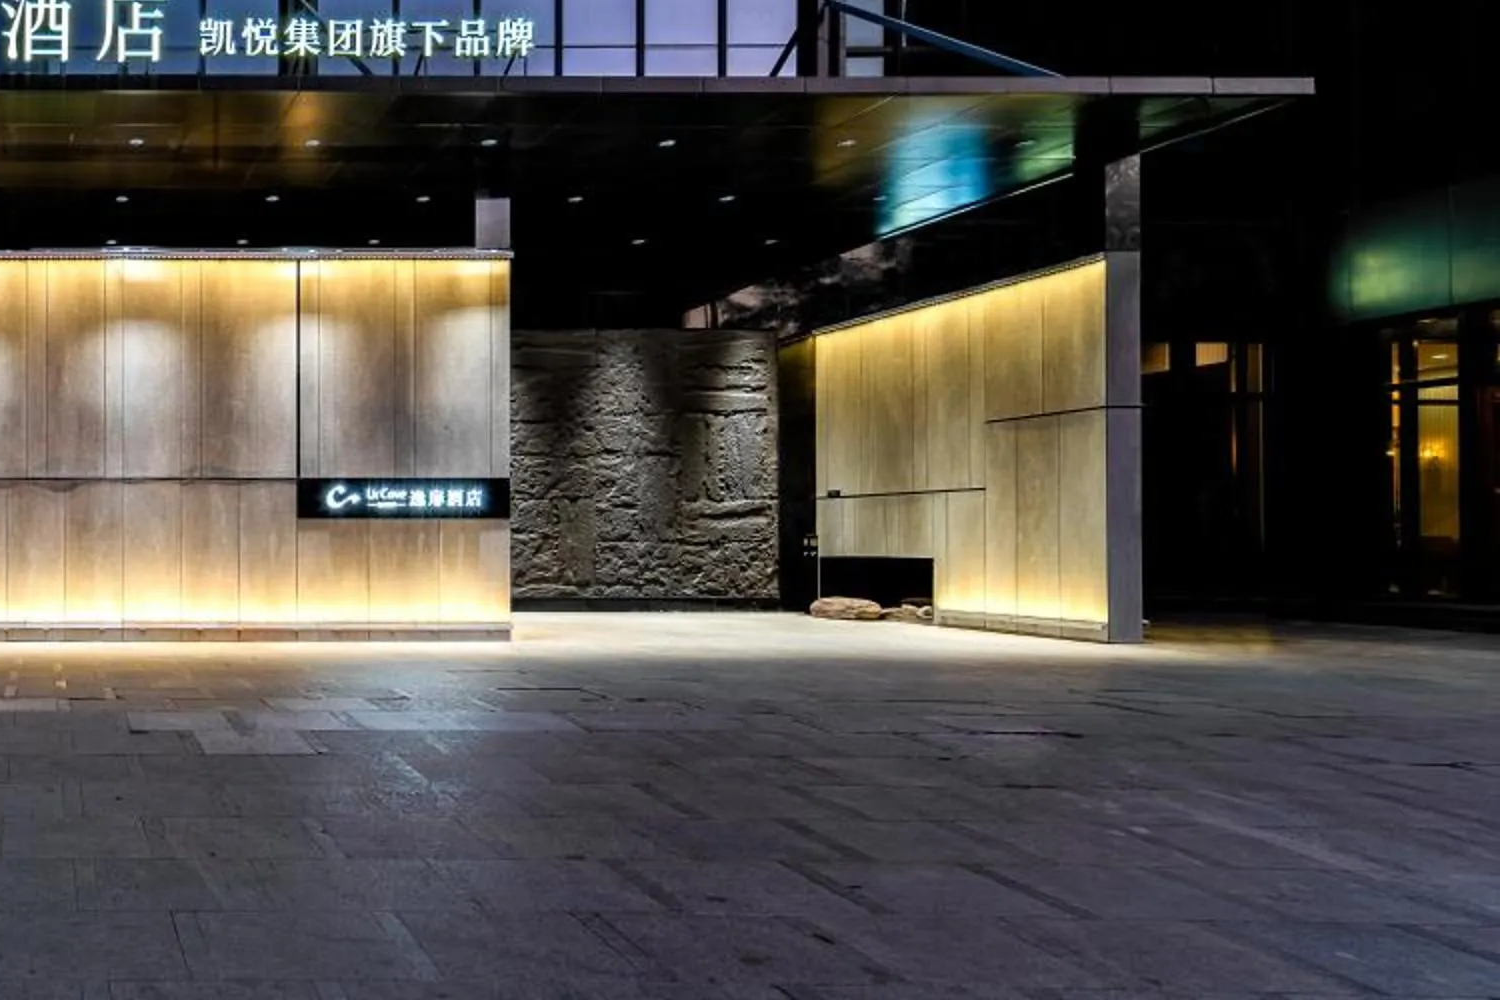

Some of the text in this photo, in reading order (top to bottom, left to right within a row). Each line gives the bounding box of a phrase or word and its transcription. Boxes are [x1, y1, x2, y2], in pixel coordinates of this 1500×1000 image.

[199, 17, 535, 58] 凯悦集团旗下品牌
